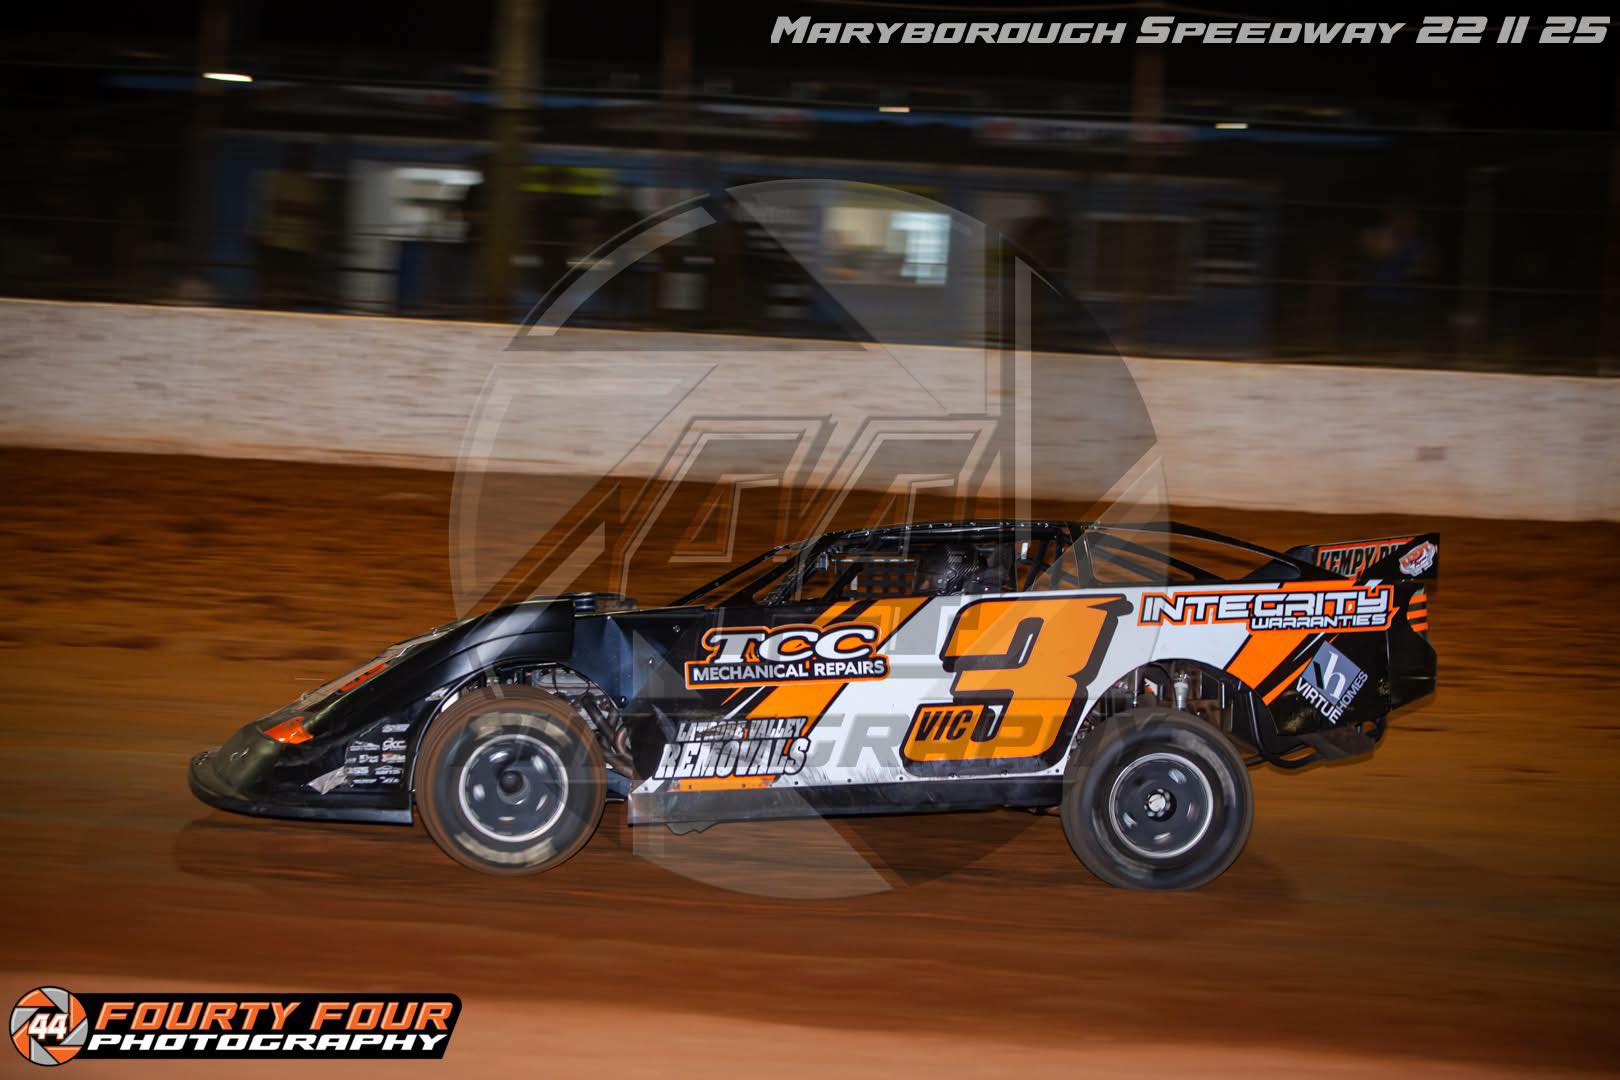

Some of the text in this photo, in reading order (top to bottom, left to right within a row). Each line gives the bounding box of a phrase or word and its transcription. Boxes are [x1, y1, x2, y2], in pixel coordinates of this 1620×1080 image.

[1142, 579, 1390, 622] INTEGRITY
[1250, 613, 1386, 630] WARRANTIES
[709, 628, 878, 664] TCC
[692, 660, 886, 682] MECHANICAL REPAIRS
[901, 594, 1131, 770] 3
[1296, 676, 1340, 725] VIRTUE
[1339, 670, 1369, 715] HOMES
[746, 717, 807, 740] VALLEY
[914, 709, 972, 742] VIC
[653, 737, 811, 780] REMOVALS
